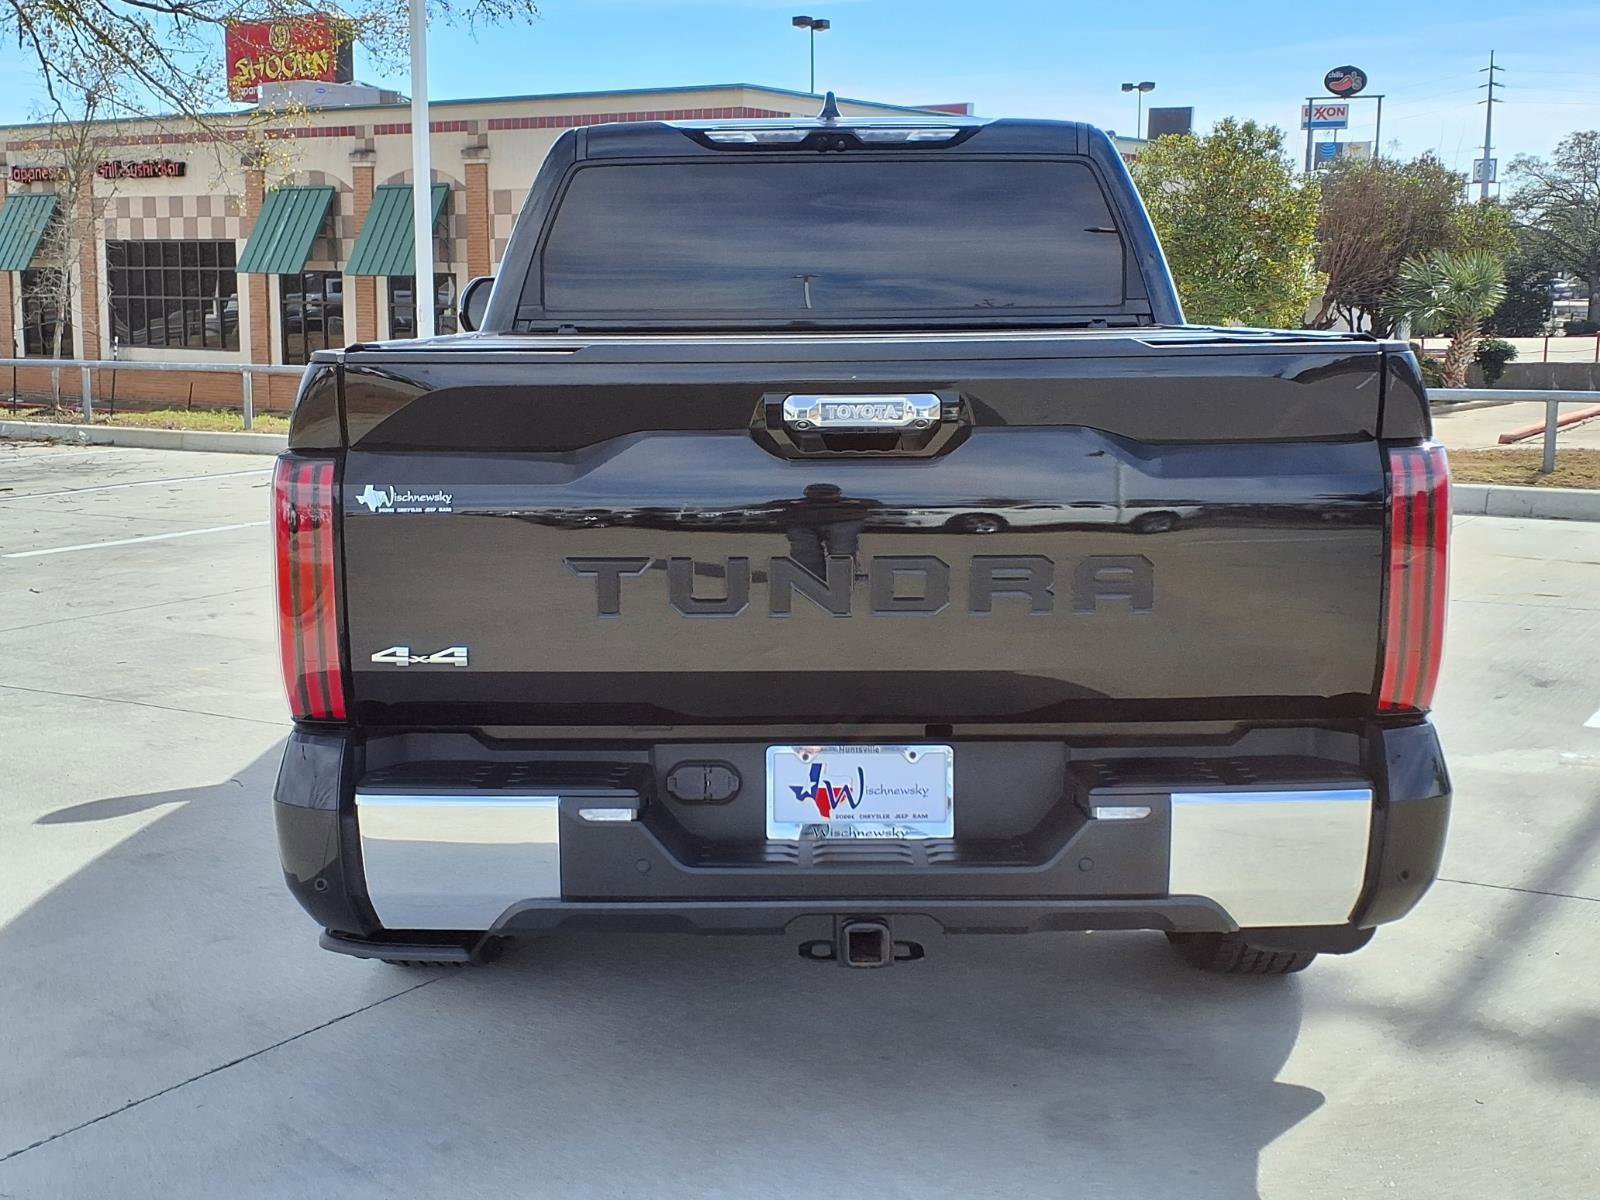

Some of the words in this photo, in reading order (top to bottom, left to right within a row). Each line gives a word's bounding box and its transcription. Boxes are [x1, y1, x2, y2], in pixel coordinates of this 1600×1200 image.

[825, 404, 897, 420] TOYOTA
[562, 555, 1154, 618] TUNDRA
[371, 646, 468, 667] 4x4
[839, 746, 880, 754] Huntsville
[823, 766, 929, 808] Wischnewsky
